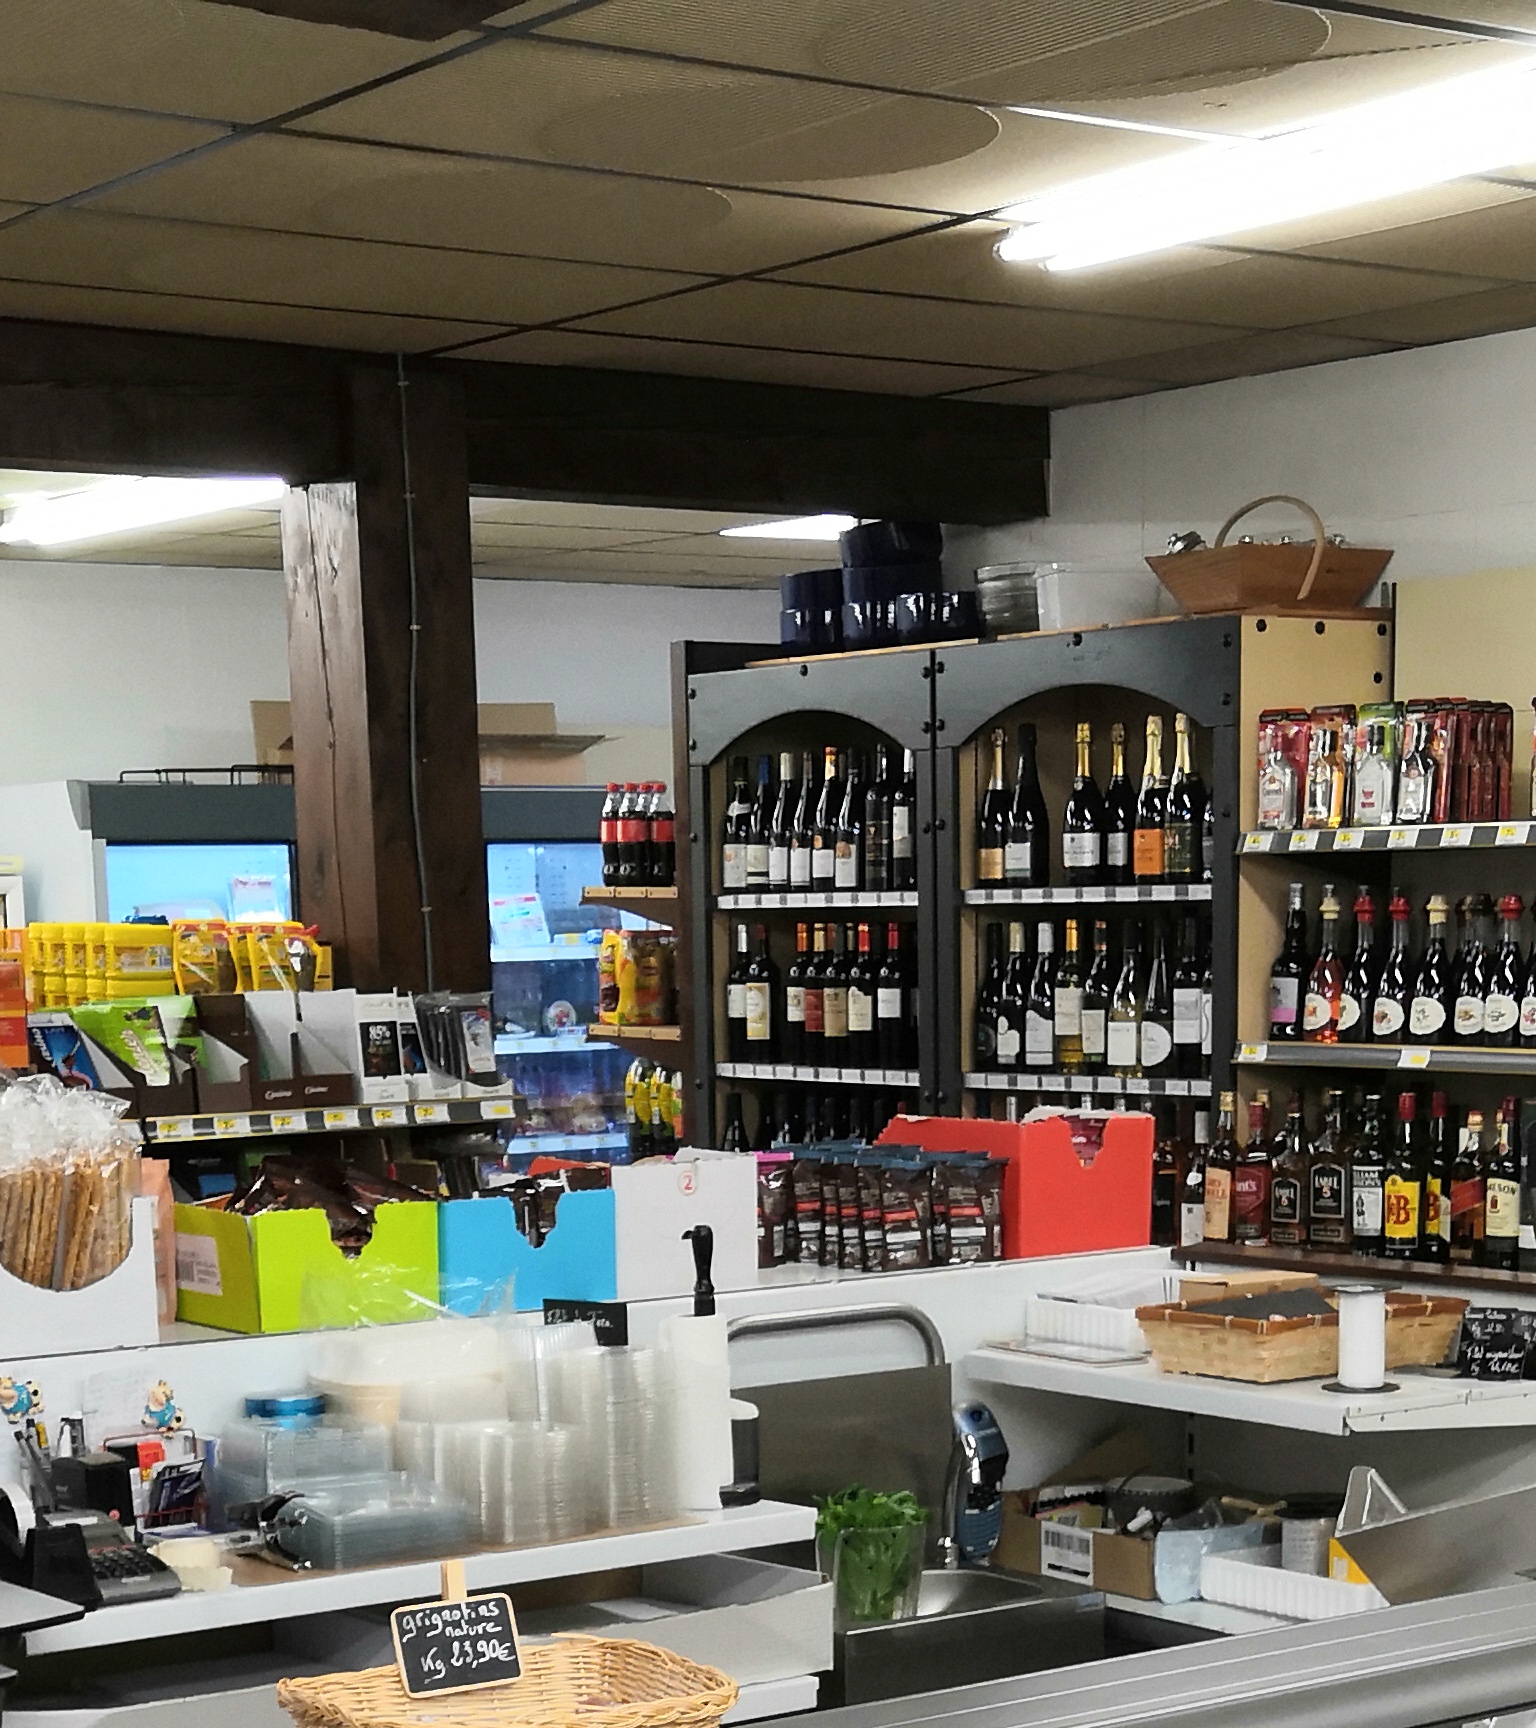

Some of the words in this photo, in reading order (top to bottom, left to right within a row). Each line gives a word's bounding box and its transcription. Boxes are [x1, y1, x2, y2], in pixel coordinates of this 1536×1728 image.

[444, 1619, 503, 1638] nature
[420, 1646, 447, 1684] Kg
[450, 1638, 517, 1668] 23,90€
